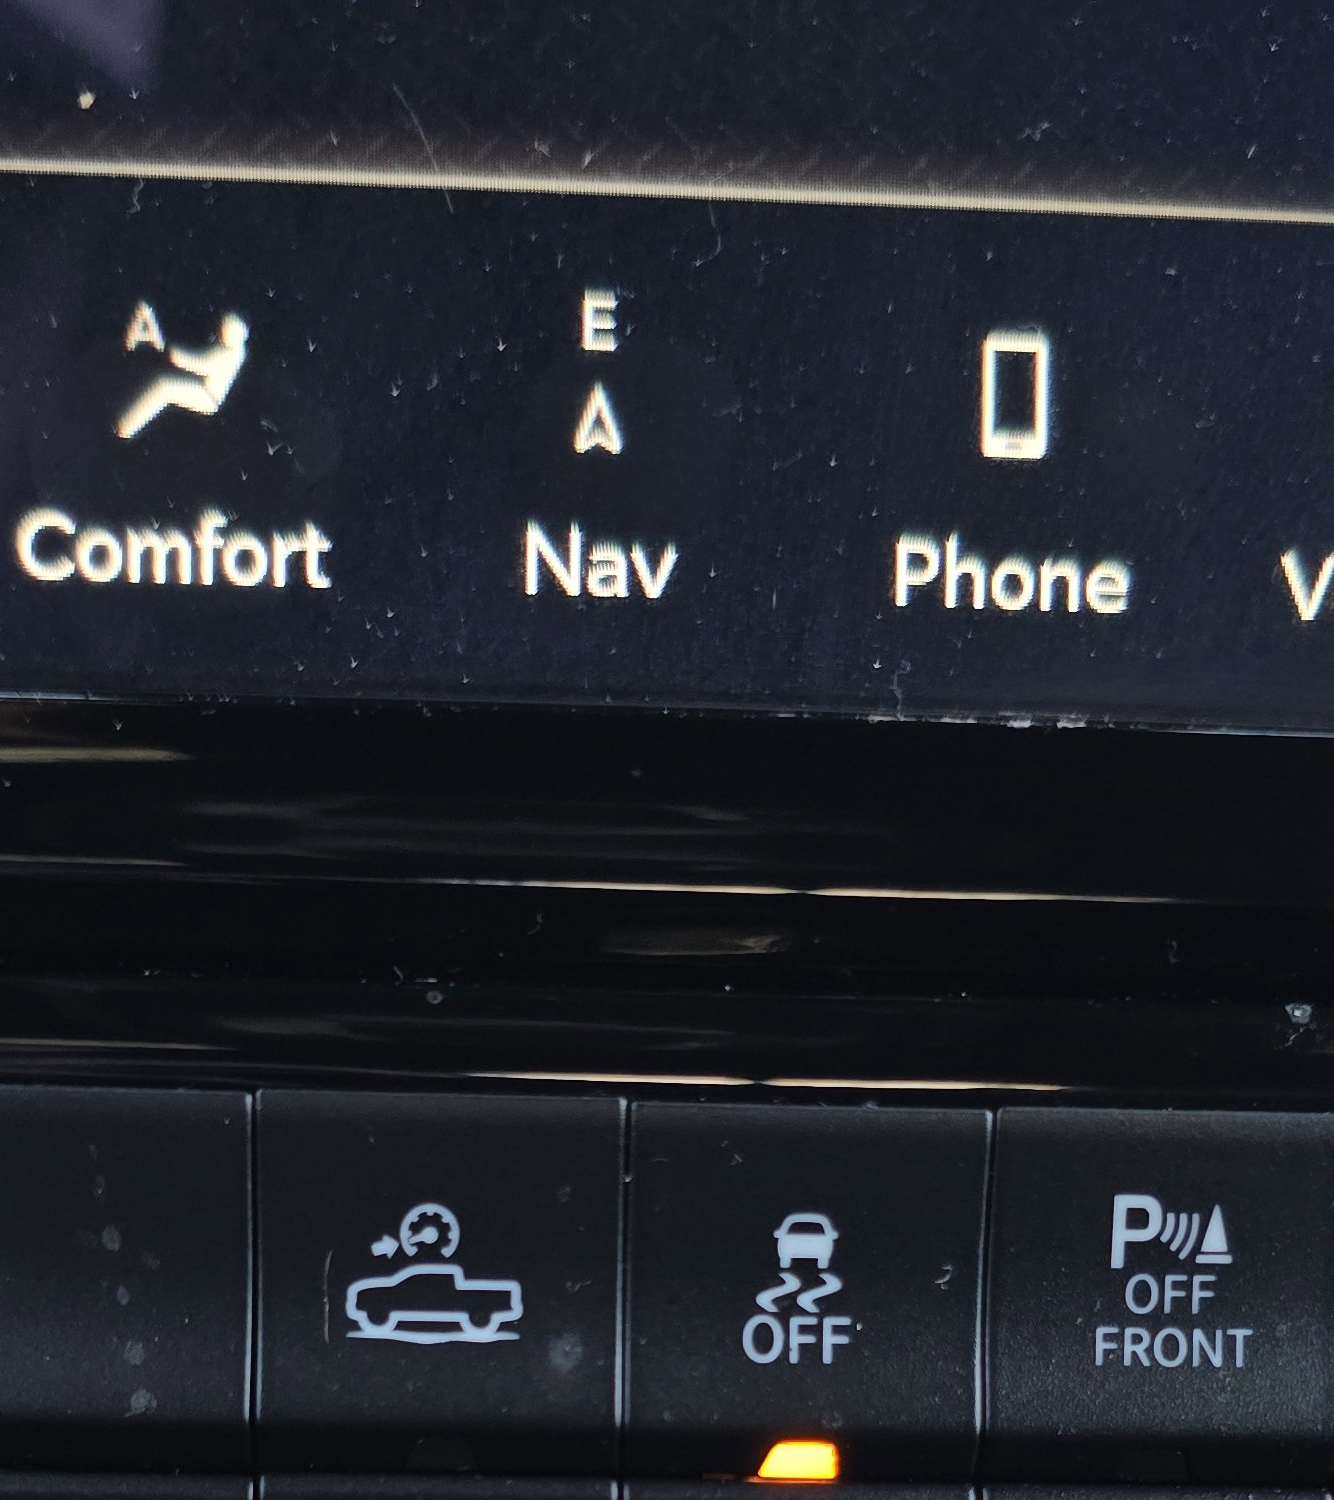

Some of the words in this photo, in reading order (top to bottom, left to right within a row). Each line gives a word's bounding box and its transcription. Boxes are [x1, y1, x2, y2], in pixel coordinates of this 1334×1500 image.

[582, 291, 618, 351] E
[16, 509, 332, 588] Comfort
[525, 522, 678, 598] Nav
[895, 534, 1129, 613] Phone
[1111, 1195, 1161, 1268] P
[1126, 1274, 1215, 1314] OFF
[743, 1315, 851, 1364] OFF
[1096, 1327, 1253, 1367] FRONT
